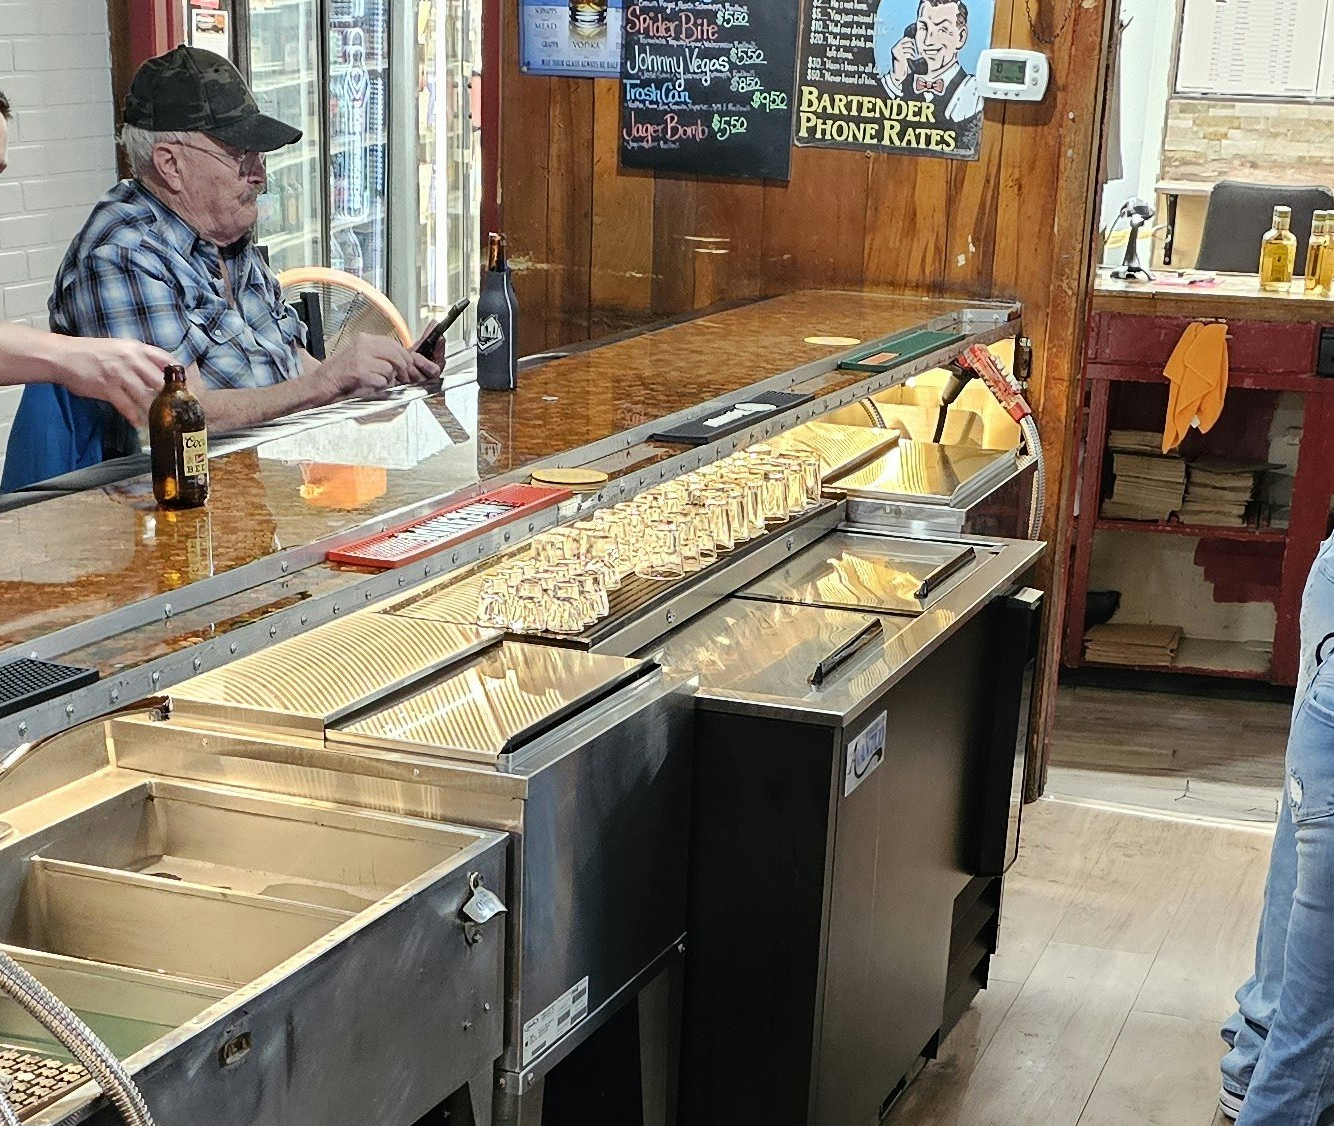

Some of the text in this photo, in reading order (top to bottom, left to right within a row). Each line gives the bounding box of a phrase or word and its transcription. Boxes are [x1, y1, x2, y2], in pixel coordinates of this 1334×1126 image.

[627, 5, 678, 37] Spider
[679, 12, 719, 42] Bite
[573, 41, 601, 49] VODKA
[627, 45, 684, 91] Johnny
[685, 48, 730, 87] Vegas
[799, 85, 936, 123] BARTENDER
[623, 110, 663, 145] Jager
[664, 112, 709, 142] Bomb
[798, 112, 957, 151] PHONE RATES
